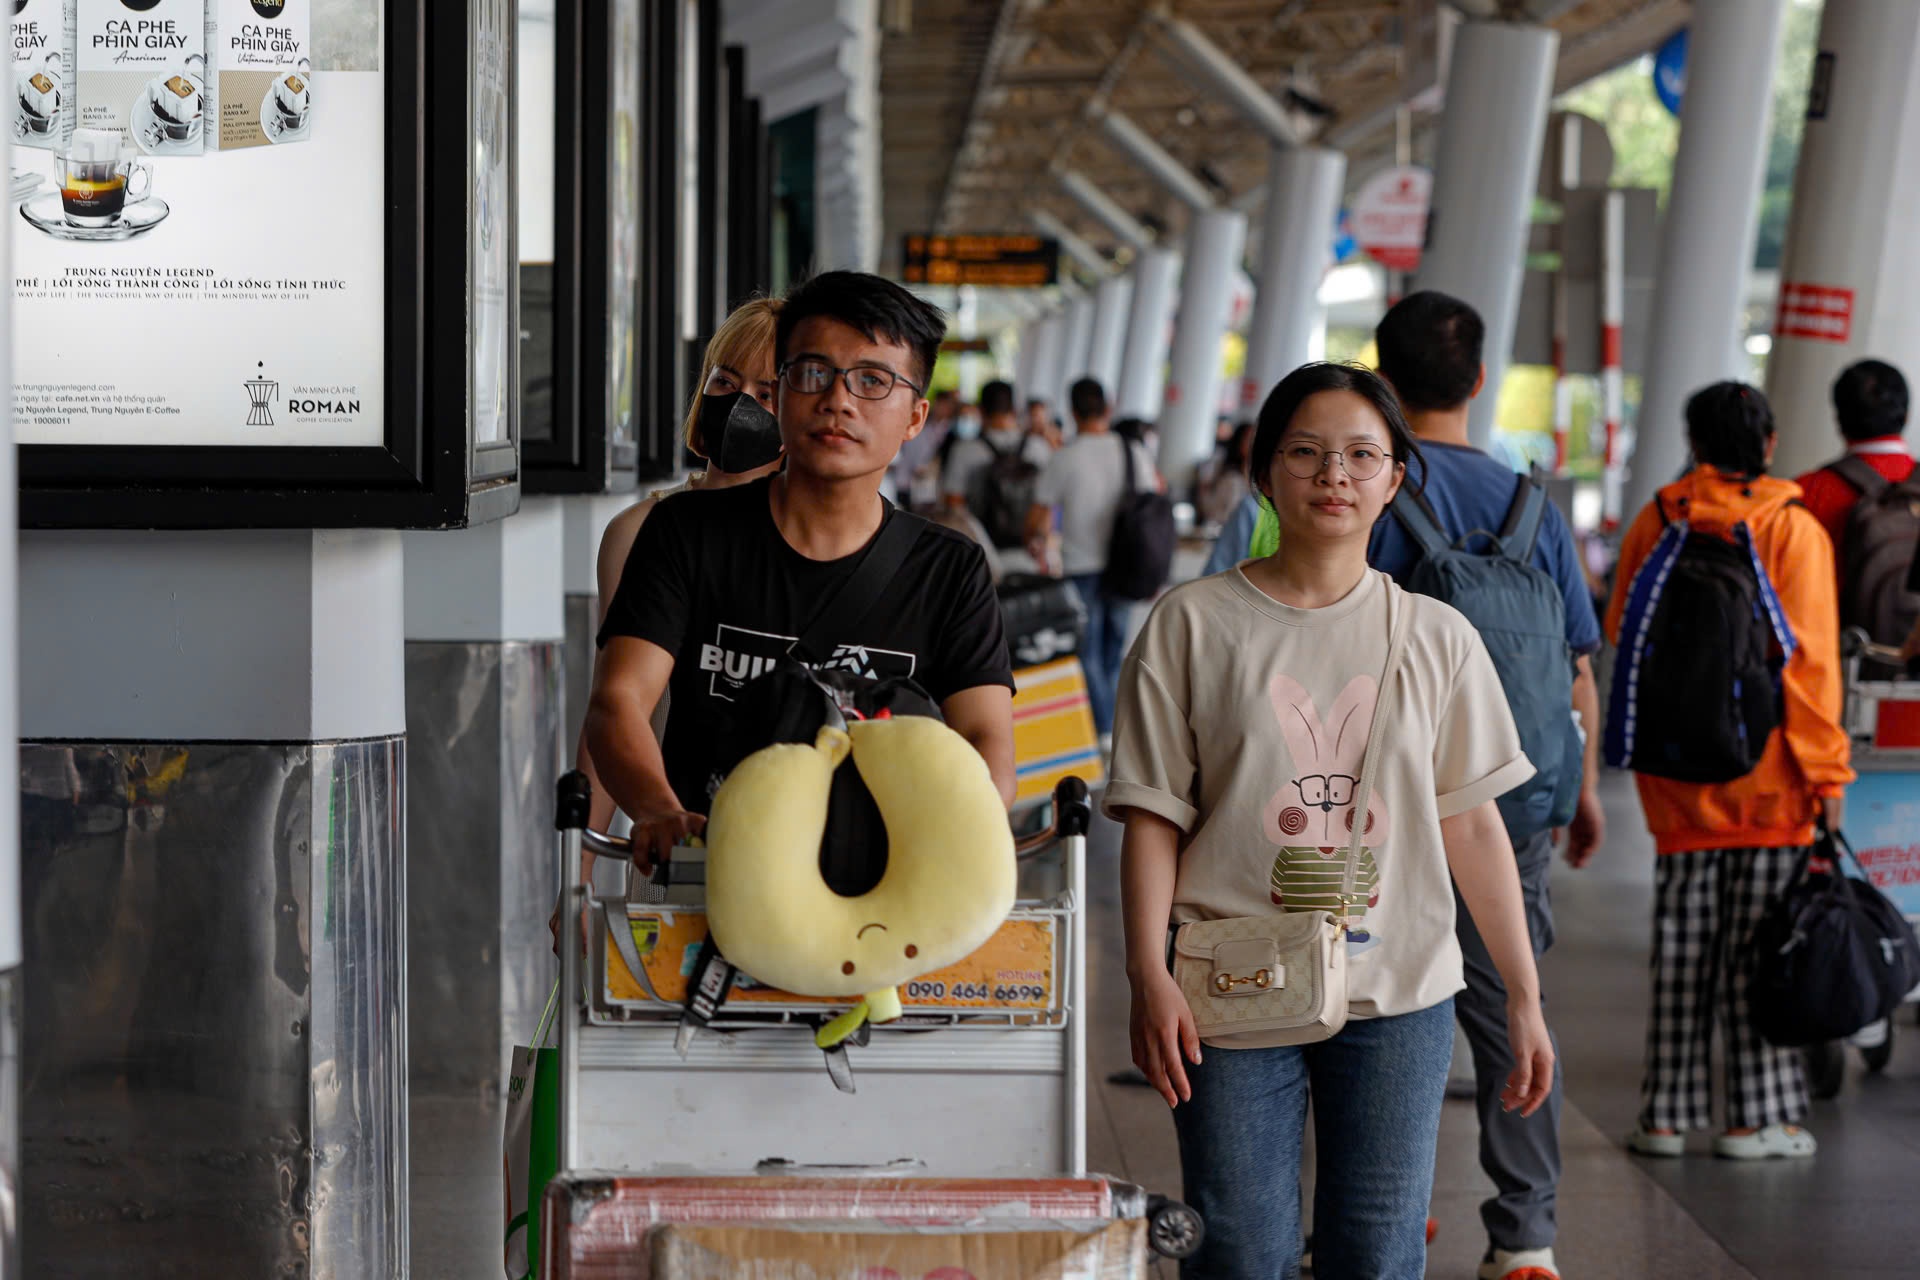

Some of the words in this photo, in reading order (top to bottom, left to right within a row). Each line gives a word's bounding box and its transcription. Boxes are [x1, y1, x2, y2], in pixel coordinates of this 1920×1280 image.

[92, 35, 139, 48] PHIN
[231, 37, 267, 52] PHIN
[112, 50, 167, 65] Americano
[64, 267, 107, 276] TRUNG
[111, 266, 162, 277] NGUYÊN
[166, 267, 214, 277] LEGEND
[16, 277, 40, 288] PHÊ
[116, 277, 160, 289] THÀNH
[289, 400, 360, 414] ROMAN
[34, 417, 71, 425] 19006011
[997, 970, 1042, 980] HOTLINE
[908, 982, 945, 998] 090
[951, 983, 988, 999] 464
[994, 984, 1044, 1001] 6699
